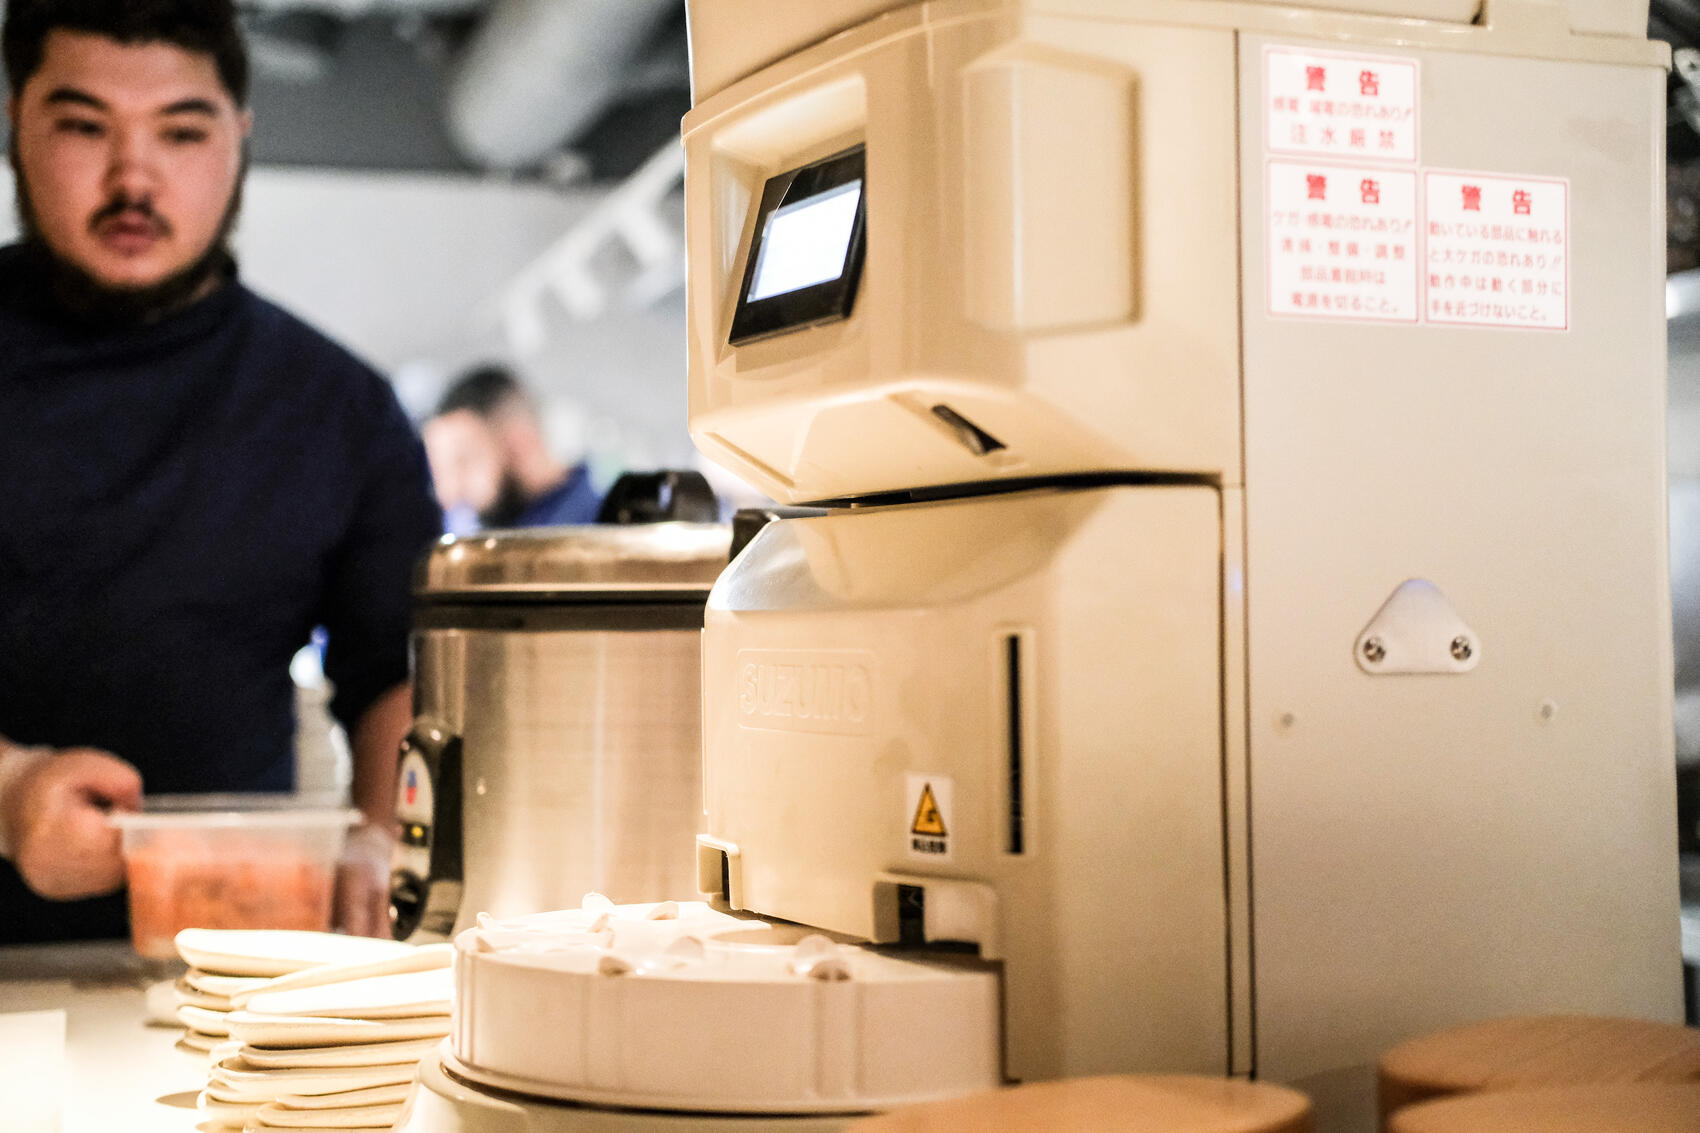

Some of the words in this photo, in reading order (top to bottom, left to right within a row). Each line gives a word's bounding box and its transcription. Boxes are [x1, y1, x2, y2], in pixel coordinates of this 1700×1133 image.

[1306, 66, 1379, 96] 警告
[1306, 174, 1380, 204] 警告
[1461, 184, 1532, 215] 警告
